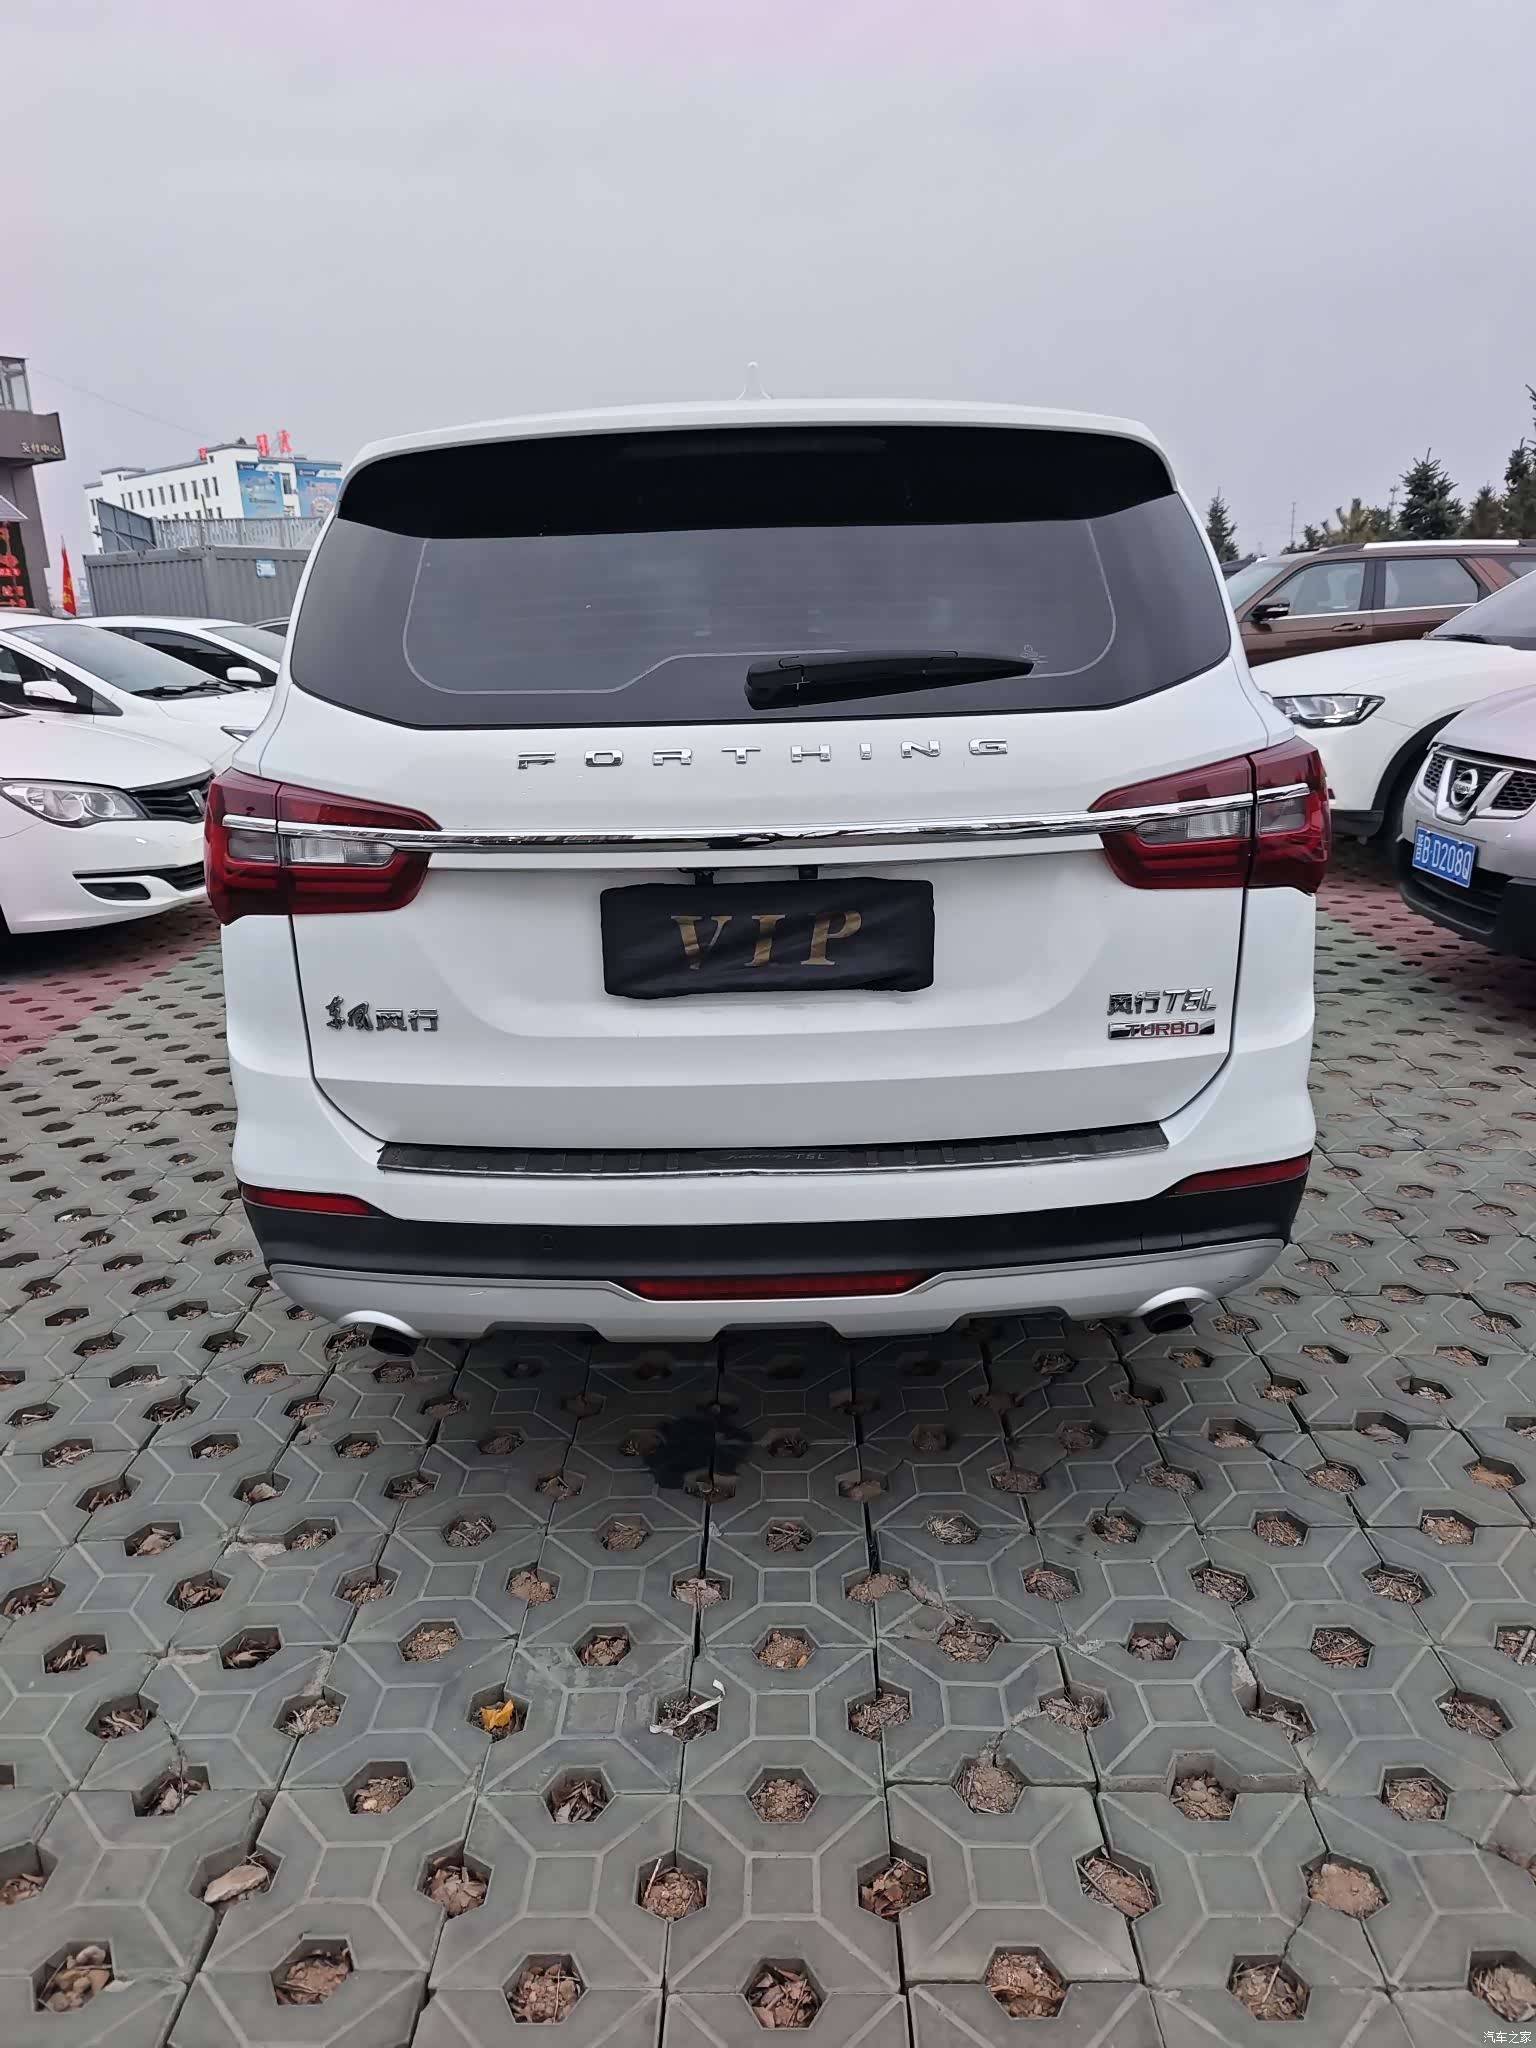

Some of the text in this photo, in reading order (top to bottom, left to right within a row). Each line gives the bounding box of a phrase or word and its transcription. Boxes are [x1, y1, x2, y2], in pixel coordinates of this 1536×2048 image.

[517, 738, 1008, 770] FORTHING
[670, 909, 863, 970] VIP
[1125, 1021, 1199, 1038] TURBO
